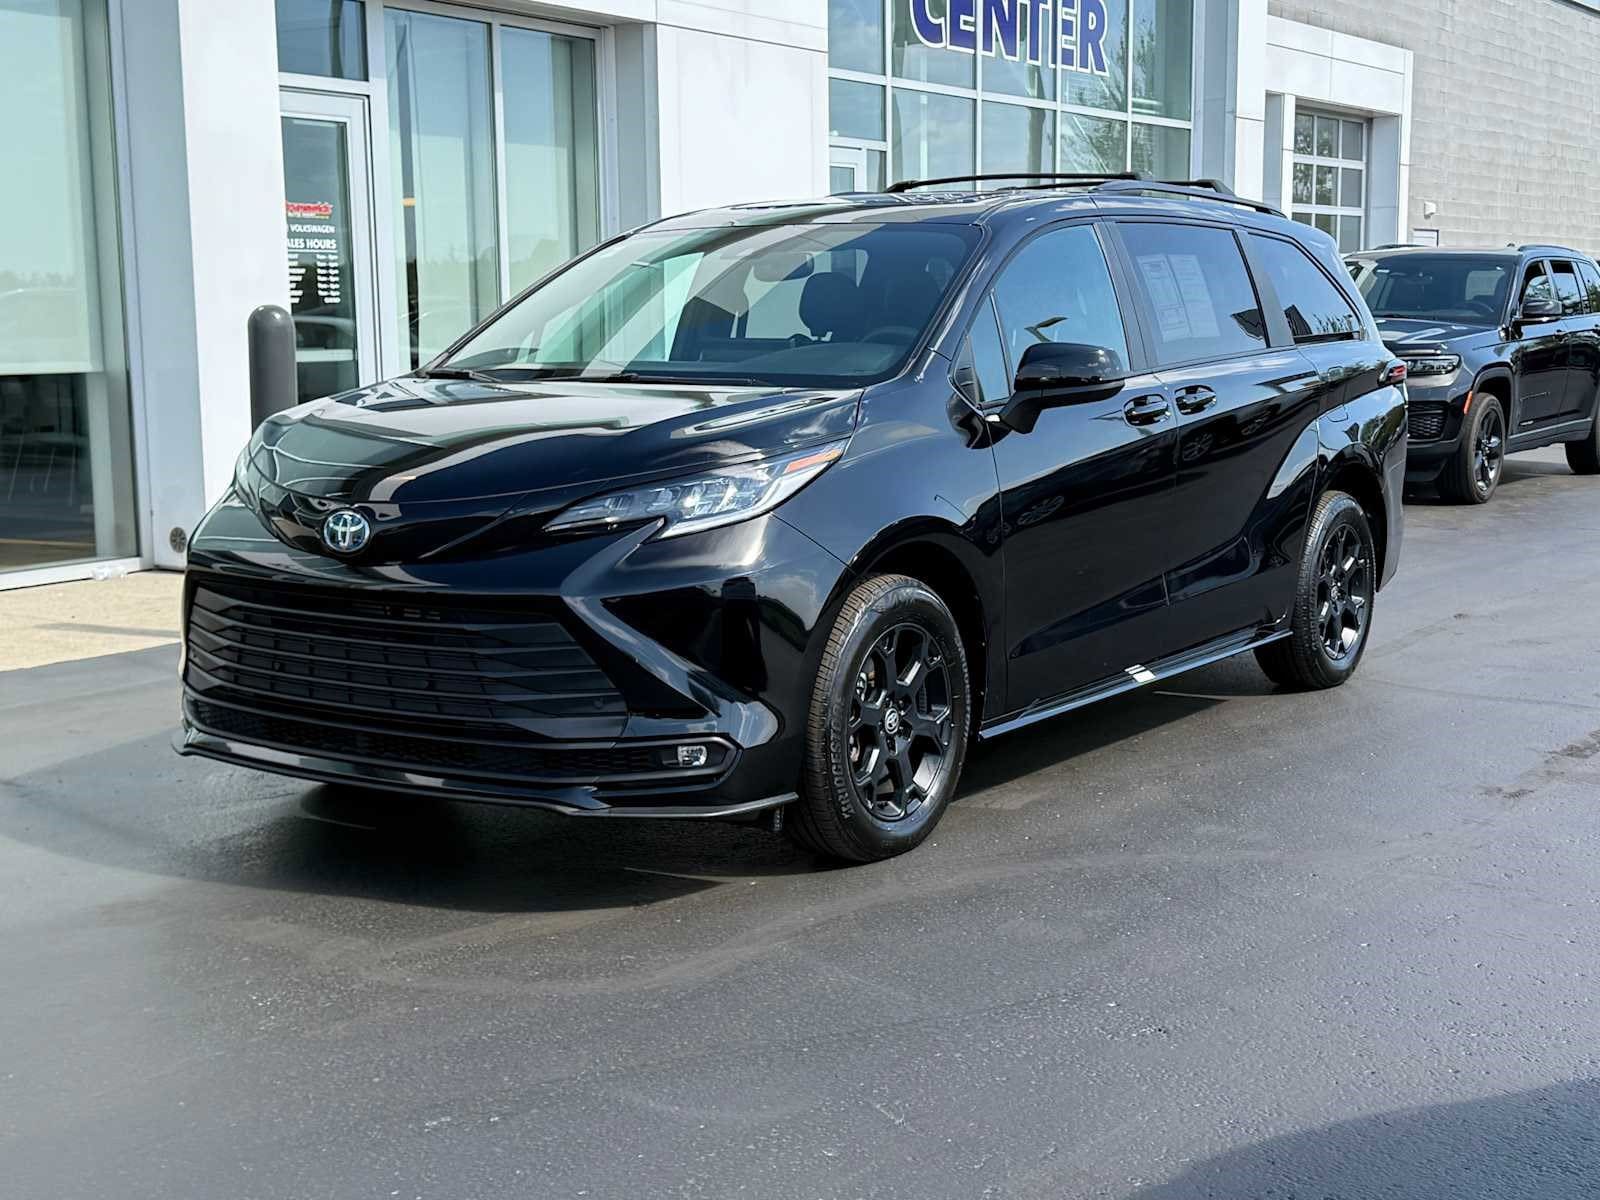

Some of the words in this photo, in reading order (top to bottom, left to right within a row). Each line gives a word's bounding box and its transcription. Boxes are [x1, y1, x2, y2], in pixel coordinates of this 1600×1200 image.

[910, 0, 1109, 77] CENTER
[290, 224, 336, 234] VOLKSWAGEN
[287, 239, 305, 249] ALES
[306, 239, 337, 249] HOURS
